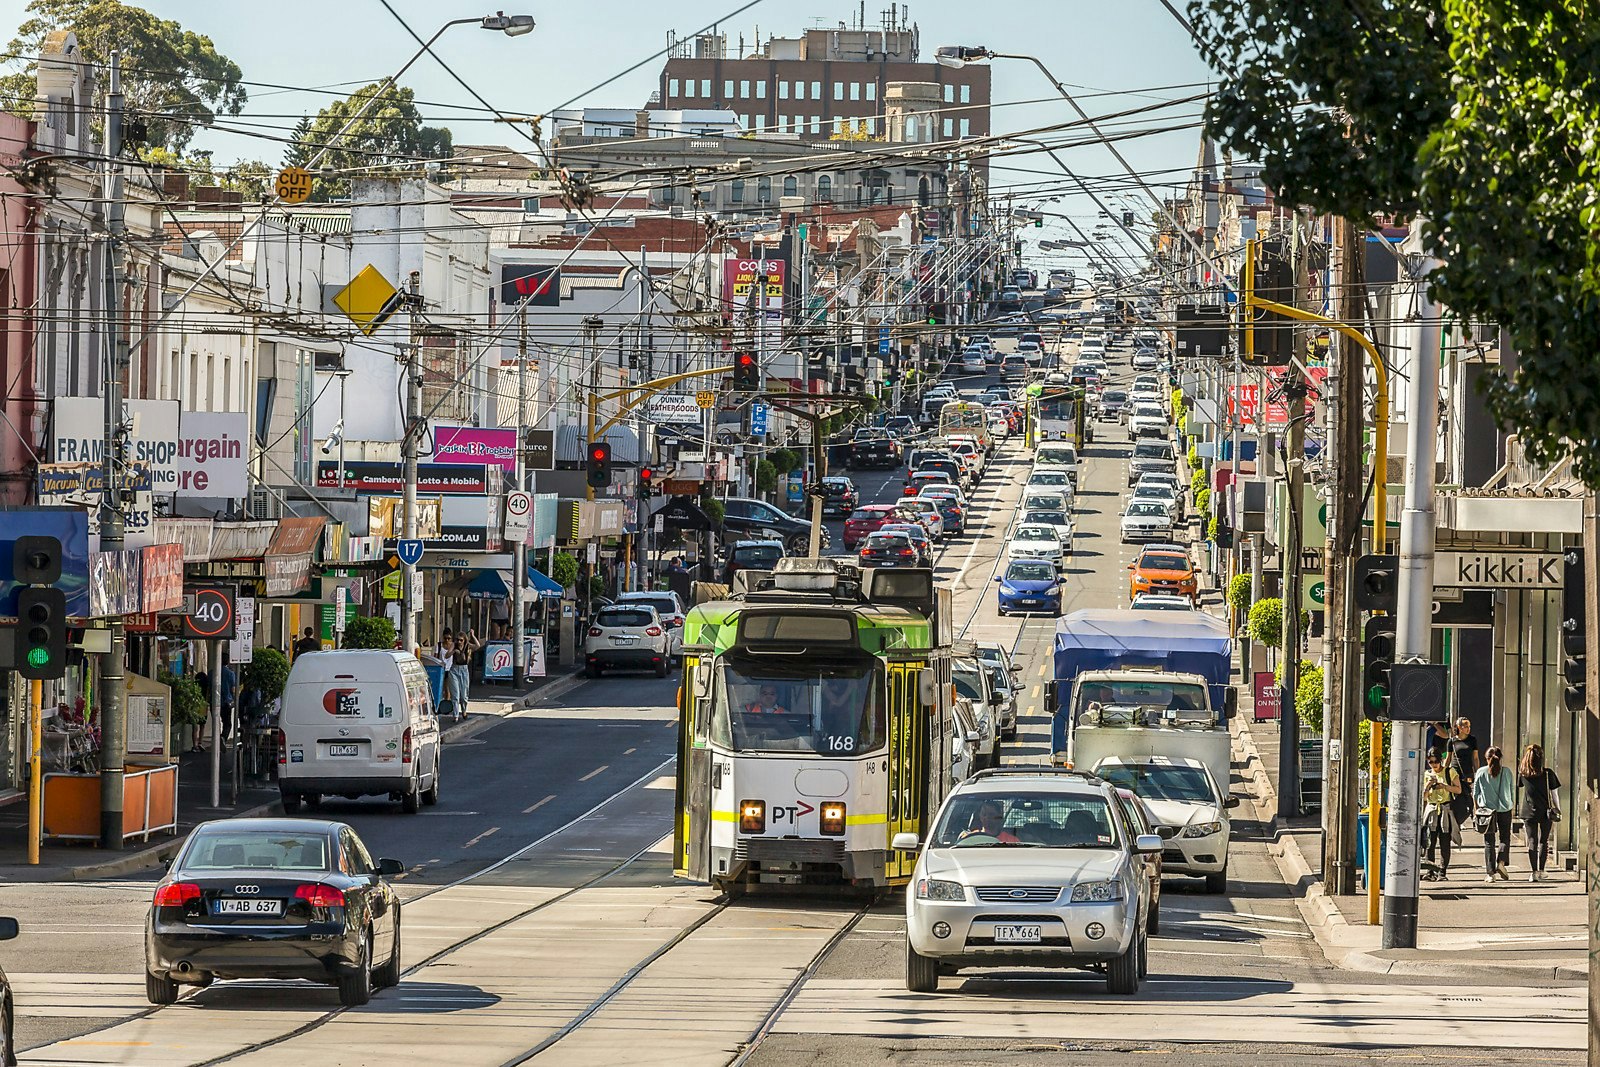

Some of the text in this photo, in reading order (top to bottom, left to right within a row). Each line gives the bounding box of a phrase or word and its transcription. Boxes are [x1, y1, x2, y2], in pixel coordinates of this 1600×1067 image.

[280, 172, 308, 185] CUT
[278, 186, 307, 198] OFF
[756, 406, 763, 416] P
[136, 440, 176, 464] SHOP
[178, 434, 240, 463] argain
[438, 443, 467, 454] baskin
[486, 446, 515, 456] robbins
[151, 470, 176, 482] ING
[363, 475, 406, 484] Camberw
[451, 477, 480, 485] Mobile
[44, 478, 79, 491] VACUUM
[511, 498, 526, 509] 40
[404, 543, 418, 556] 17
[448, 558, 469, 566] Tatts
[1458, 556, 1558, 584] kikki.K
[1315, 588, 1324, 598] Sp
[195, 602, 223, 622] 40
[828, 735, 854, 750] 168
[722, 763, 730, 776] 168
[256, 901, 276, 912] 637
[1021, 928, 1039, 938] 664
